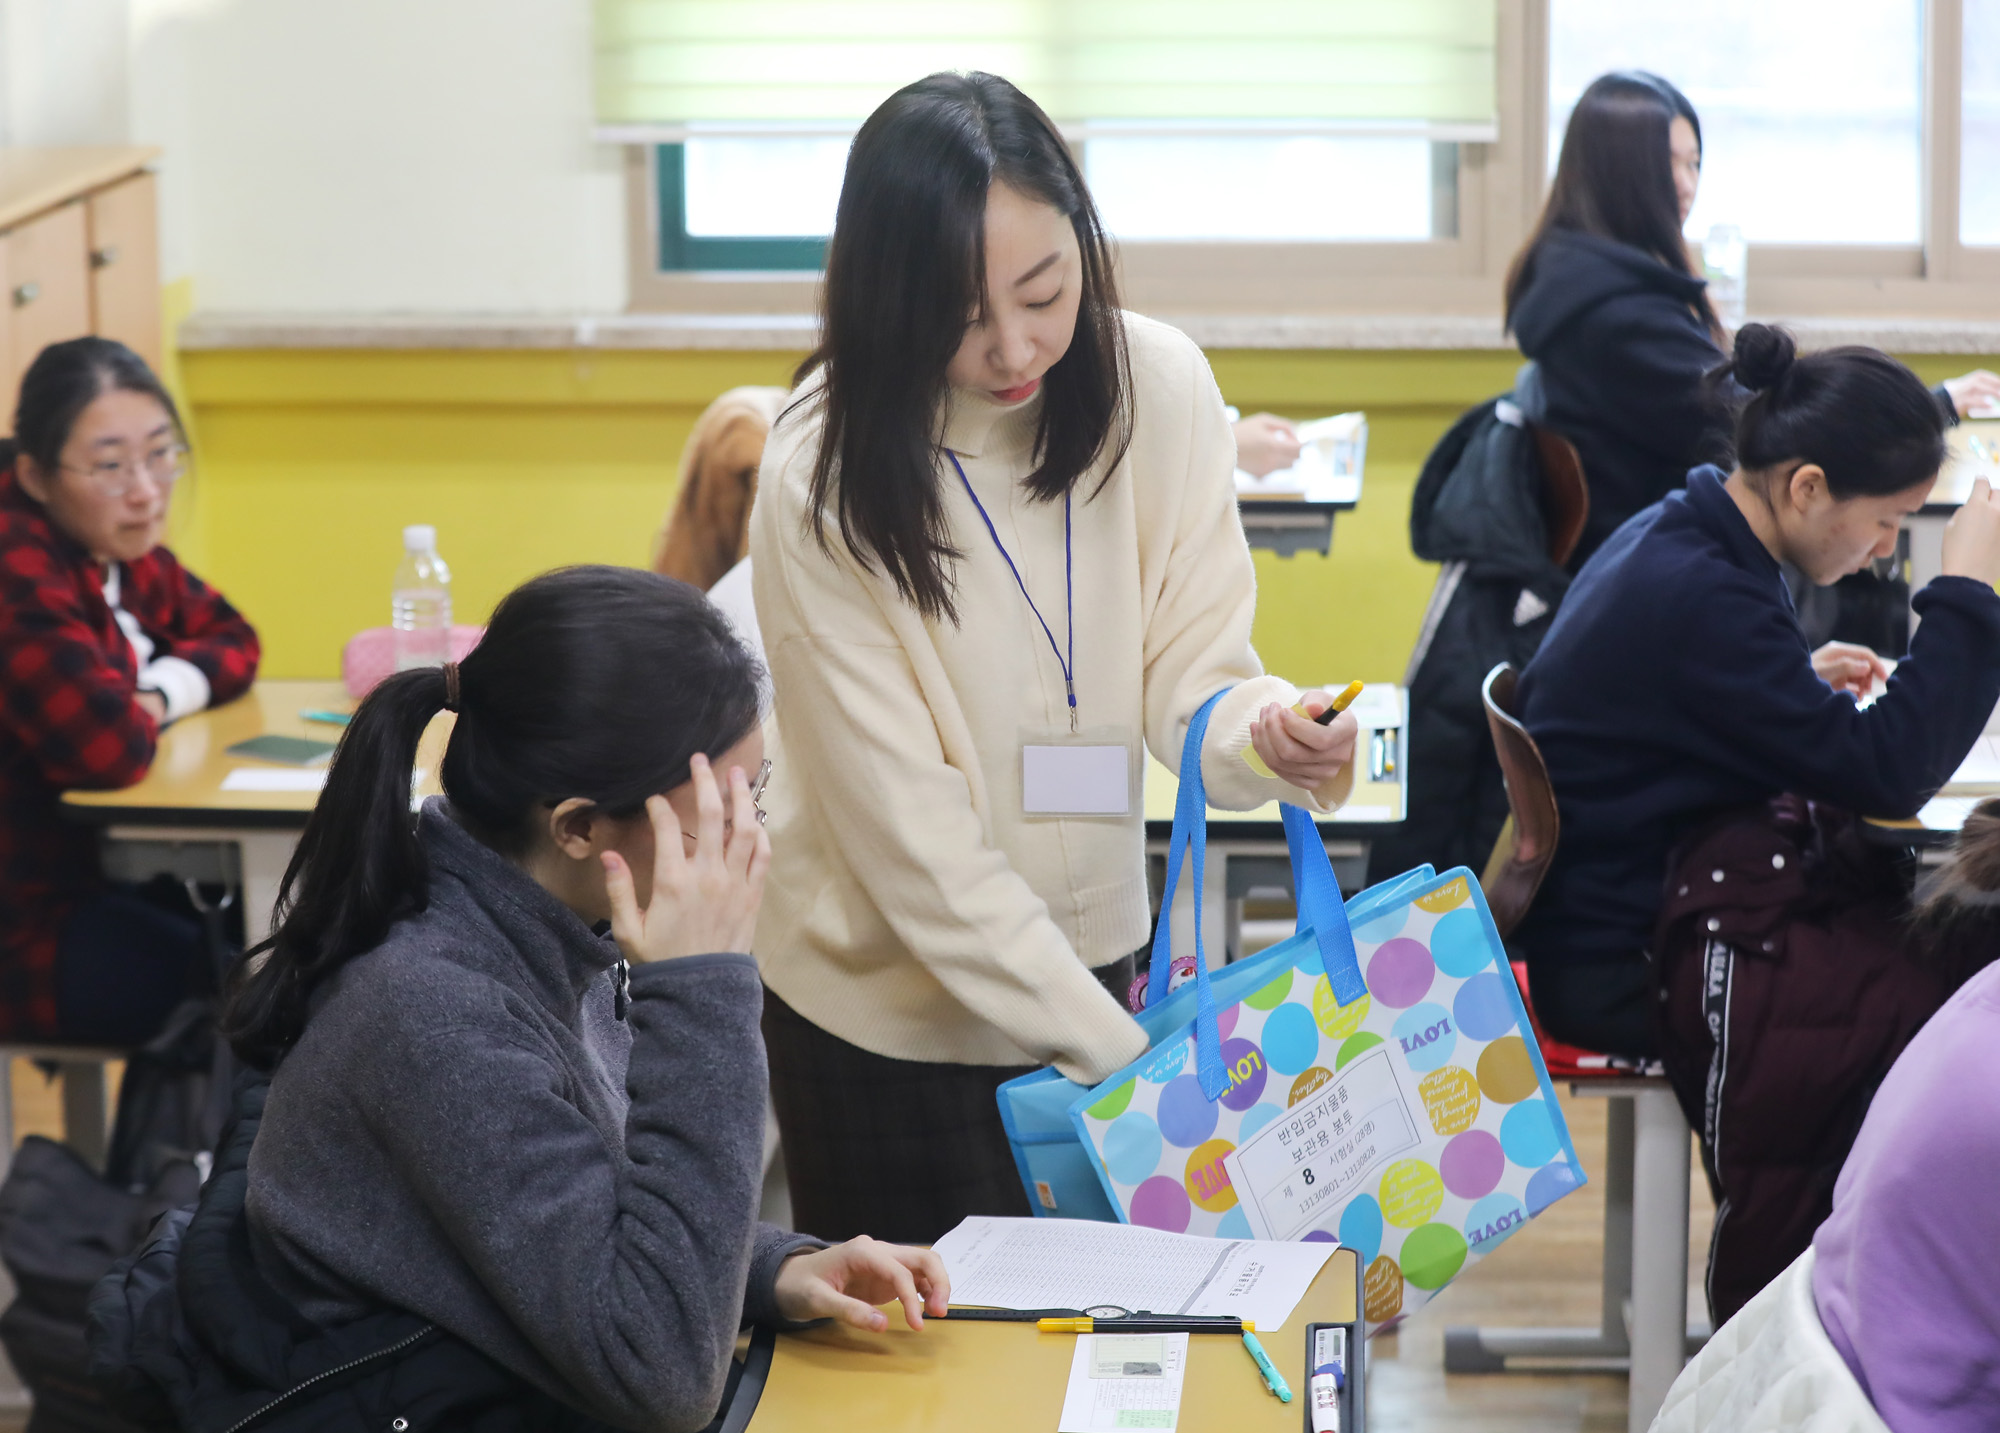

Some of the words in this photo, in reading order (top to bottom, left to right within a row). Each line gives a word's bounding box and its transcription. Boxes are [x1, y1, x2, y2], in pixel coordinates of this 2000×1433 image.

[1435, 882, 1460, 897] Love
[1221, 1050, 1263, 1097] LOV
[1277, 1085, 1349, 1146] 반입금지물품
[1291, 1130, 1330, 1165] 보관용
[1332, 1109, 1353, 1136] 봉투
[1190, 1149, 1232, 1201] OVE
[1302, 1168, 1315, 1186] 8
[1329, 1140, 1355, 1166] 시험실
[1467, 1207, 1523, 1247] LOVE
